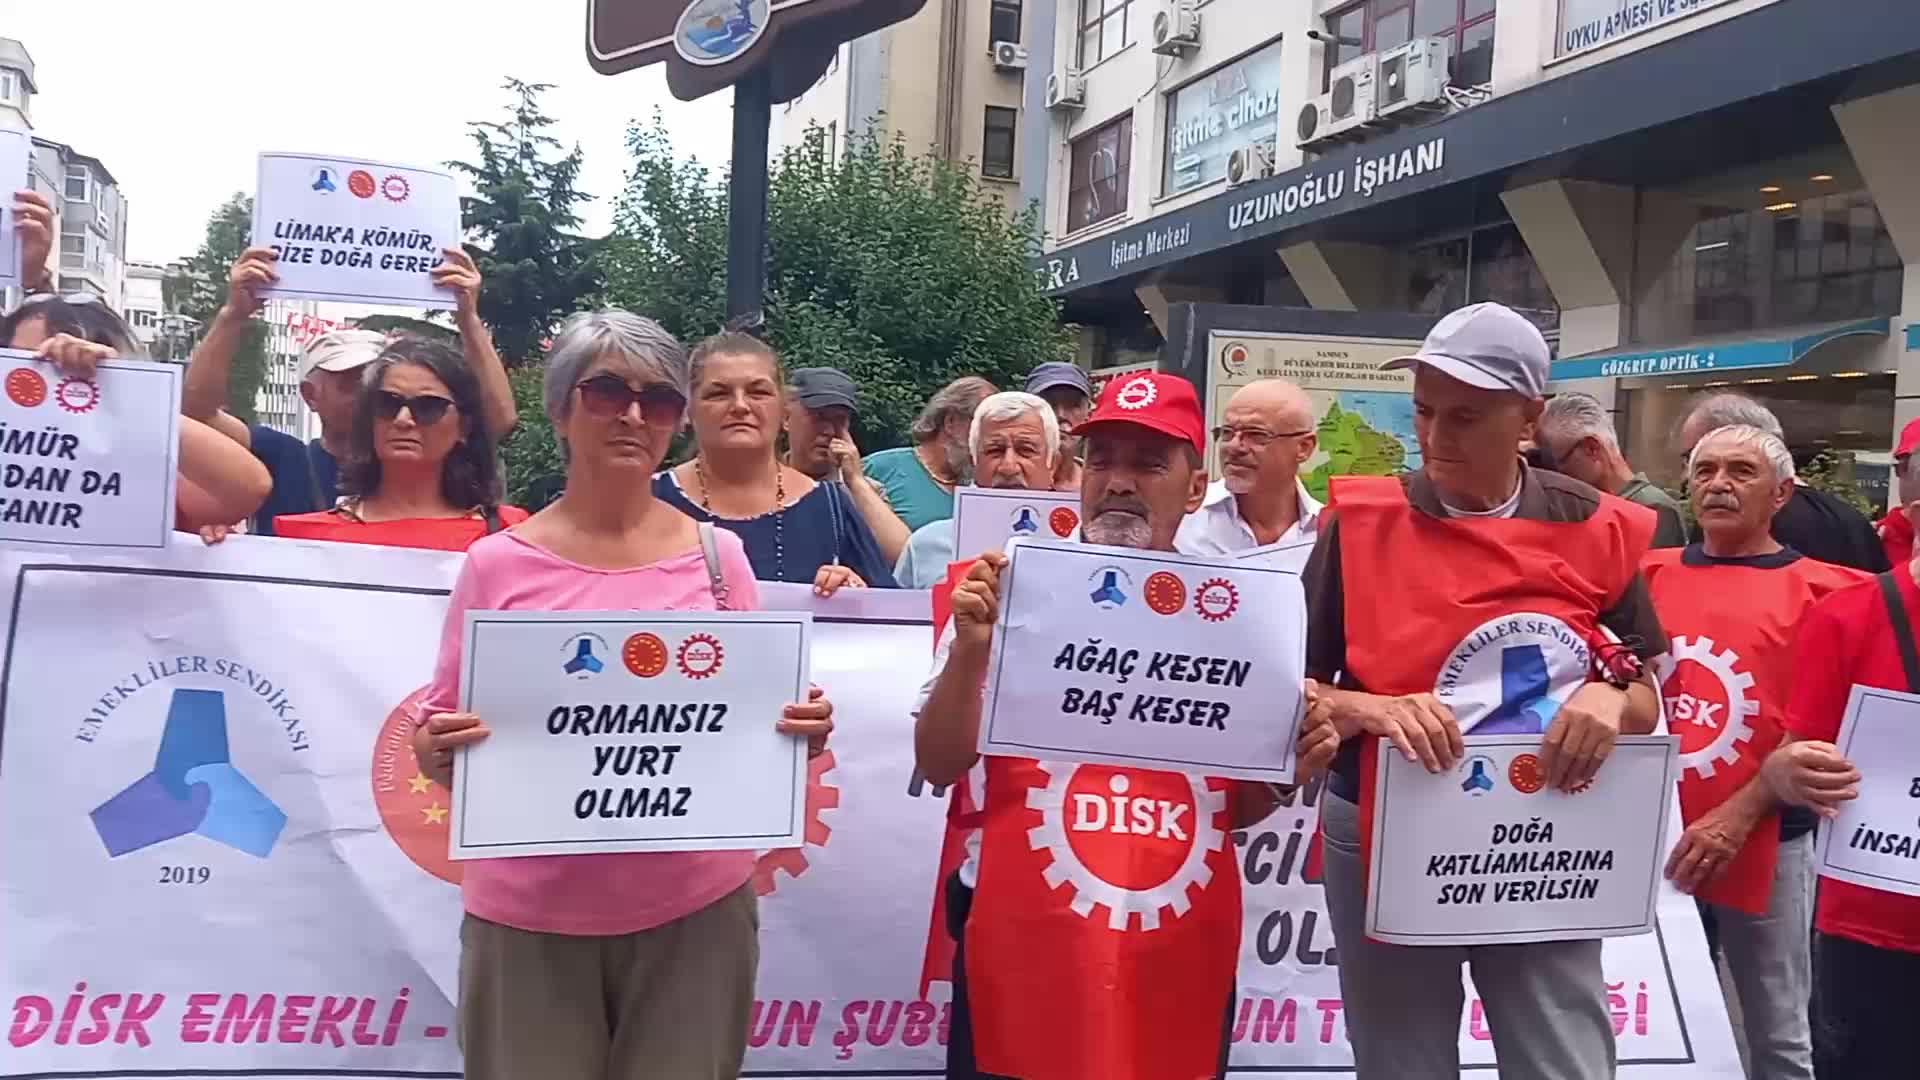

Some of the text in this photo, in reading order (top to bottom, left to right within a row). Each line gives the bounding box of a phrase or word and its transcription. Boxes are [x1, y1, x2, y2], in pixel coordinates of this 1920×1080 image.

[1566, 20, 1601, 51] UYKU
[1228, 168, 1344, 232] UZUNOĞLU
[1353, 137, 1444, 197] İŞHANI
[274, 219, 437, 253] LİMAK'A KÖMÜR,
[1110, 238, 1143, 268] İşitme
[1146, 222, 1191, 257] Merkezi
[320, 247, 373, 269] DOĞA
[80, 470, 122, 496] DA
[1053, 637, 1252, 688] AĞAÇ KESEN
[76, 655, 310, 752] EMEKLİLER SENDİKASI
[547, 703, 728, 736] ORMANSIZ
[1061, 688, 1231, 731] BAŞ KESER
[592, 745, 682, 777] YURT
[574, 787, 692, 819] OLMAZ
[1072, 774, 1189, 841] DİSK
[1491, 817, 1554, 845] DOĞA
[159, 866, 211, 884] 2019
[1426, 848, 1614, 877] KATLİAMLARINA
[1437, 874, 1600, 905] SON VERİLSİN
[8, 982, 165, 1048] DİSK
[180, 987, 410, 1048] EMEKLİ
